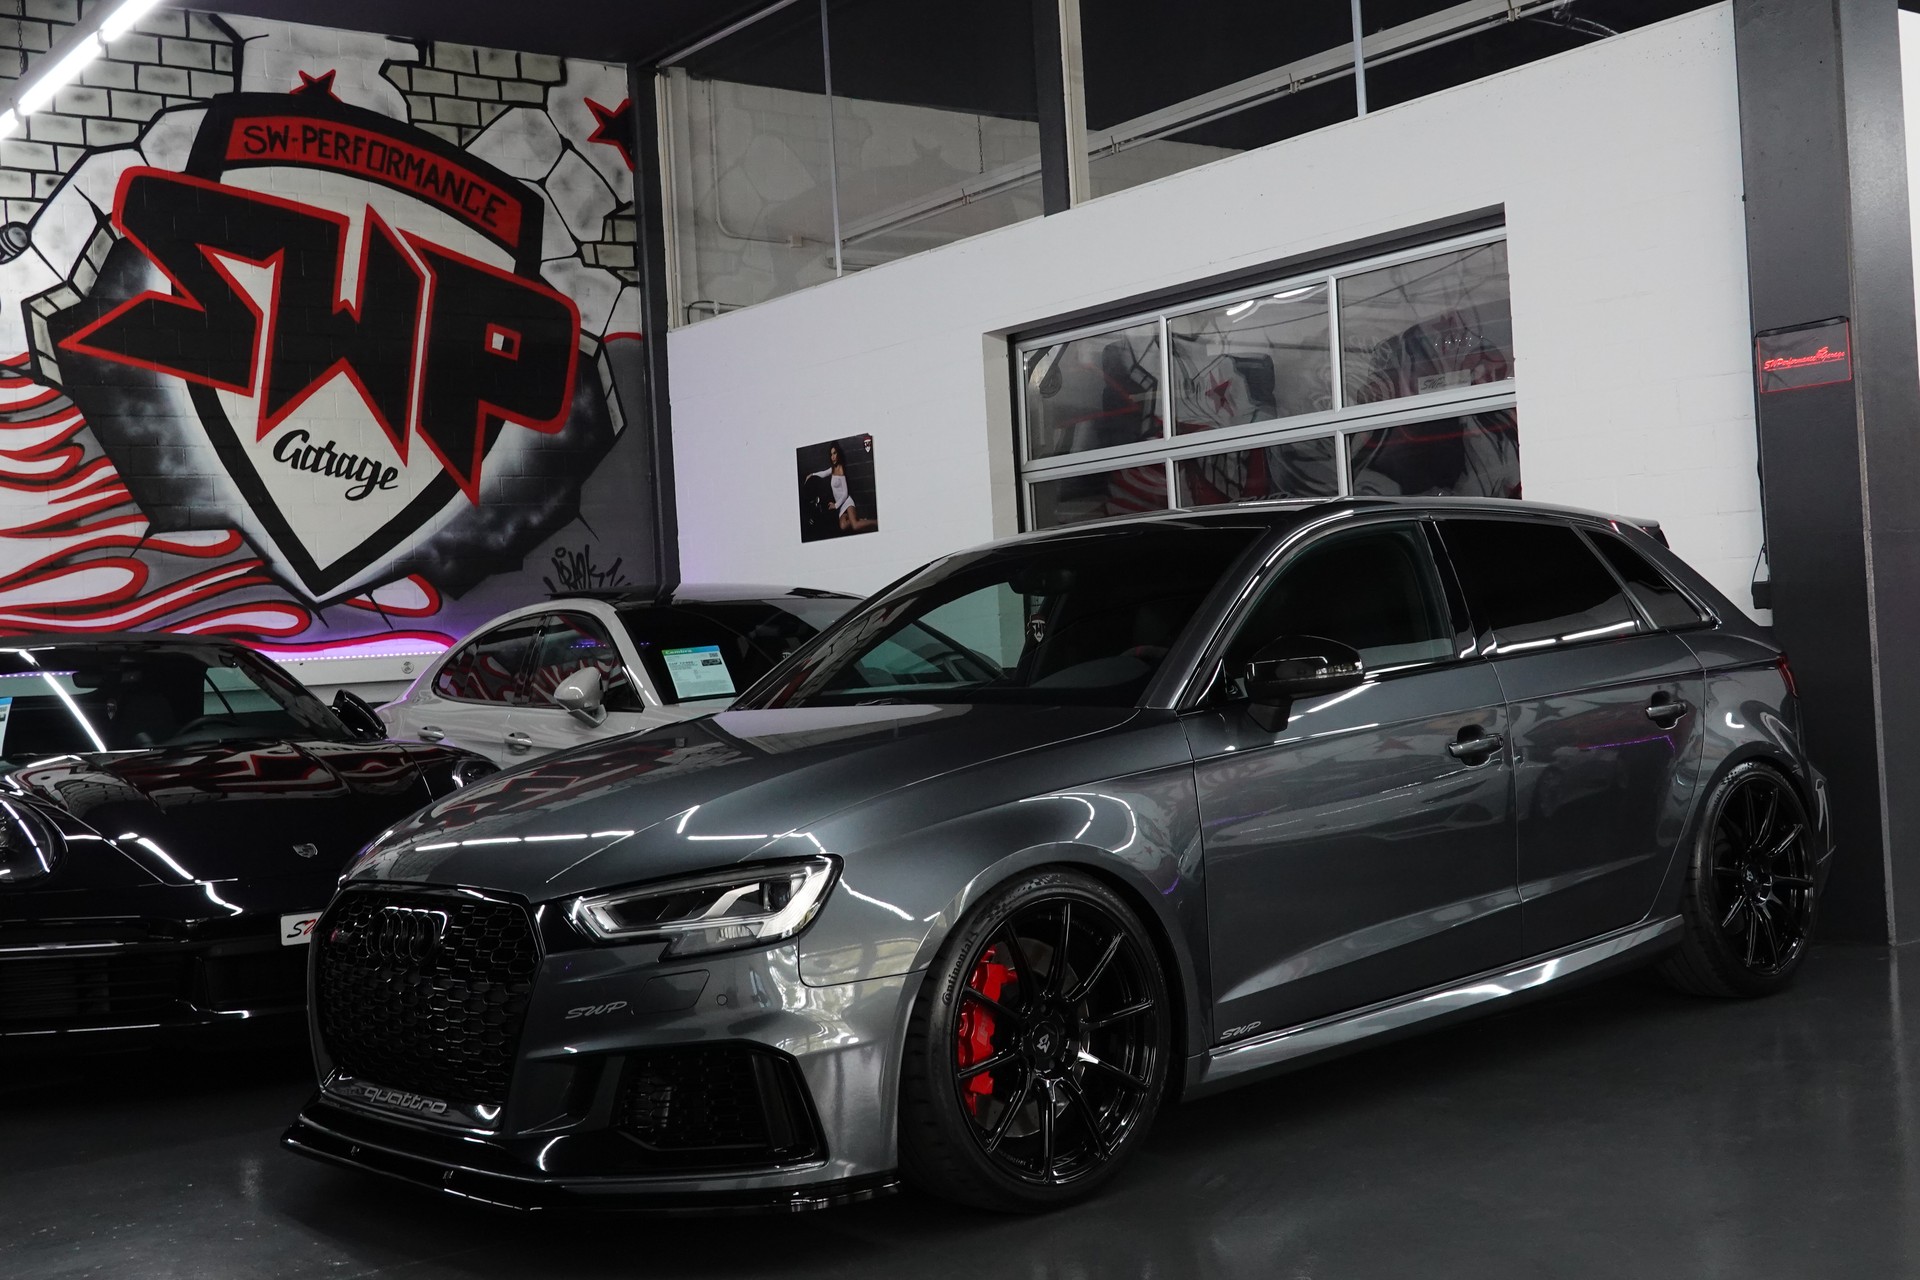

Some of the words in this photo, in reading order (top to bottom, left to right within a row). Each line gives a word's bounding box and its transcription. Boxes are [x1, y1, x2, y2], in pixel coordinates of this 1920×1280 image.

[243, 124, 506, 228] SW-PERFORMANCE
[58, 165, 581, 507] SWP
[273, 429, 398, 501] Garage
[565, 1001, 628, 1019] SWP
[1220, 1020, 1261, 1040] SWP
[364, 1087, 448, 1114] quattro
